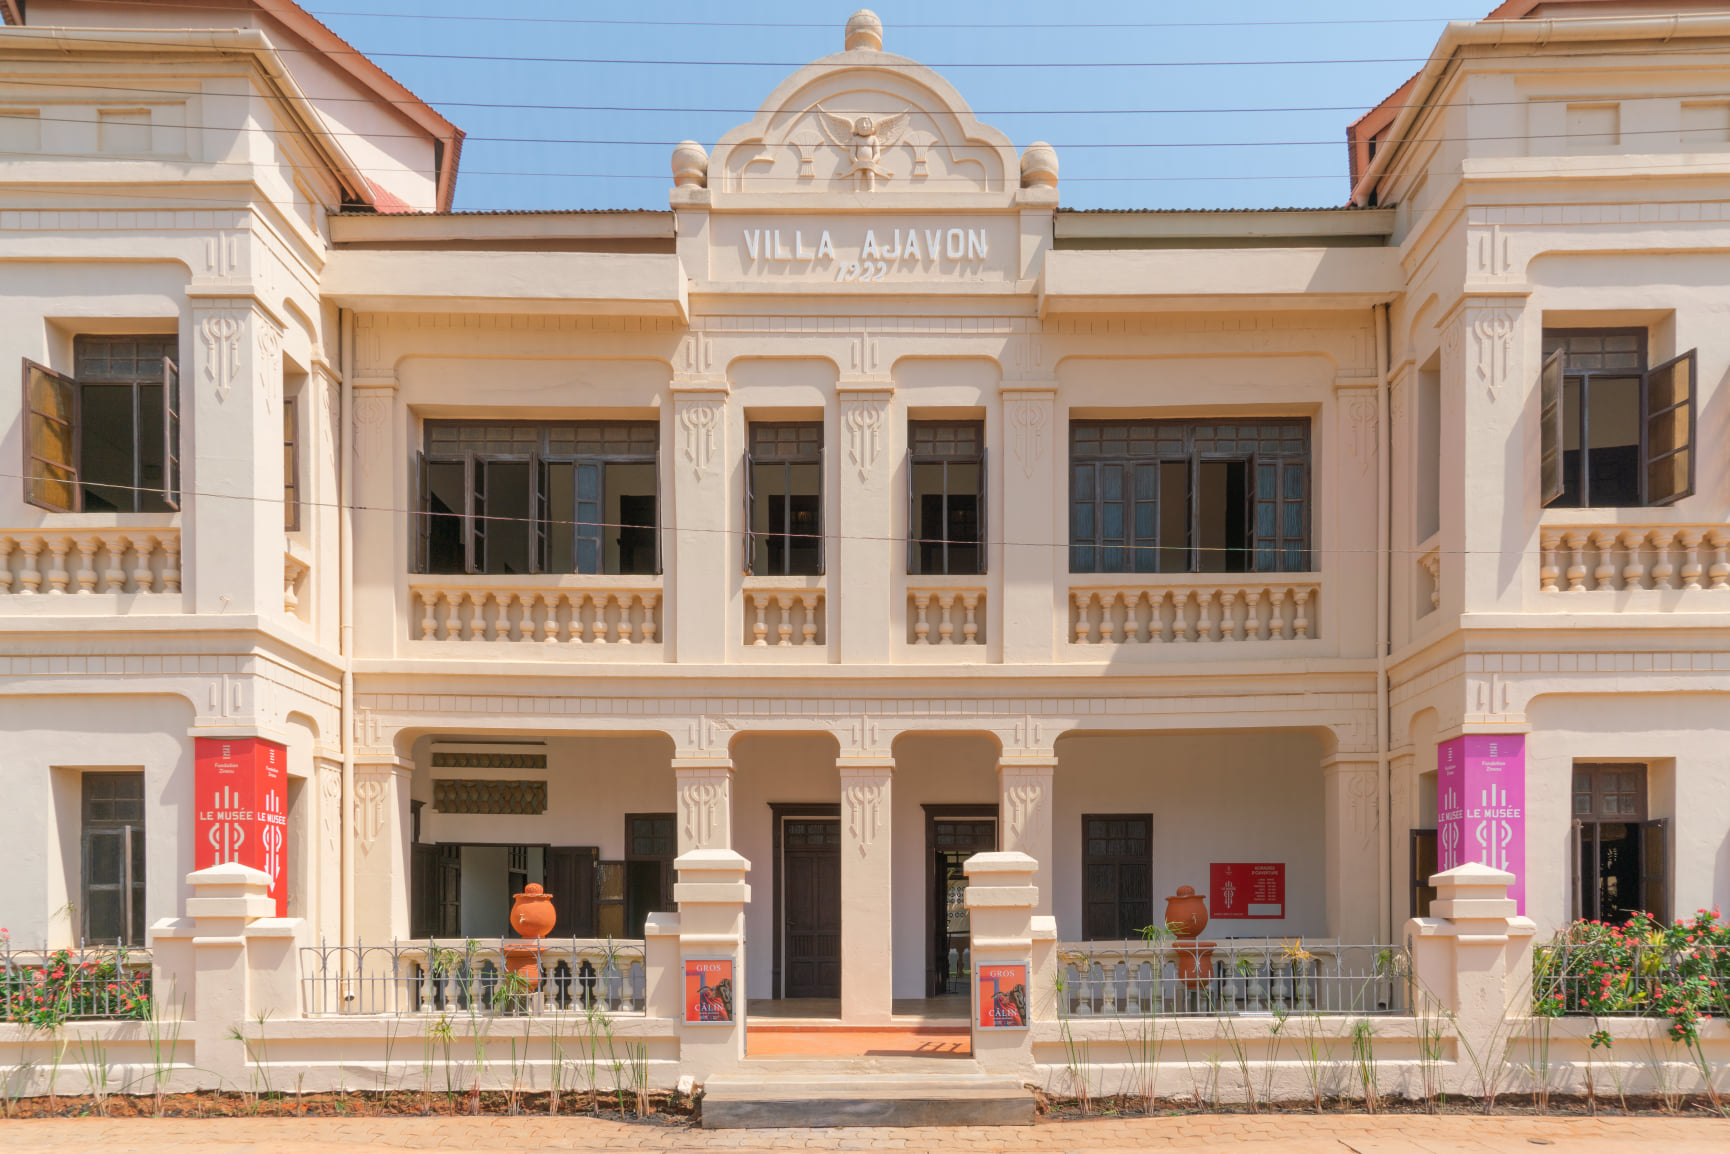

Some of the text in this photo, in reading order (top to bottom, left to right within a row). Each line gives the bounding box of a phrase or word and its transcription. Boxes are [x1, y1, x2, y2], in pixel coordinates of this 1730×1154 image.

[744, 228, 986, 260] VILLA AJAVON
[835, 261, 887, 282] 1922
[200, 807, 254, 821] LE MUSÉE
[1438, 807, 1463, 823] LE MUSÉE
[1467, 805, 1521, 818] LE MUSÉE
[257, 812, 286, 826] LE MUSÉE
[696, 964, 721, 972] GROS
[989, 970, 1015, 978] GROS
[694, 1002, 724, 1012] CÂLIN
[988, 1008, 1017, 1017] CÂLIN
